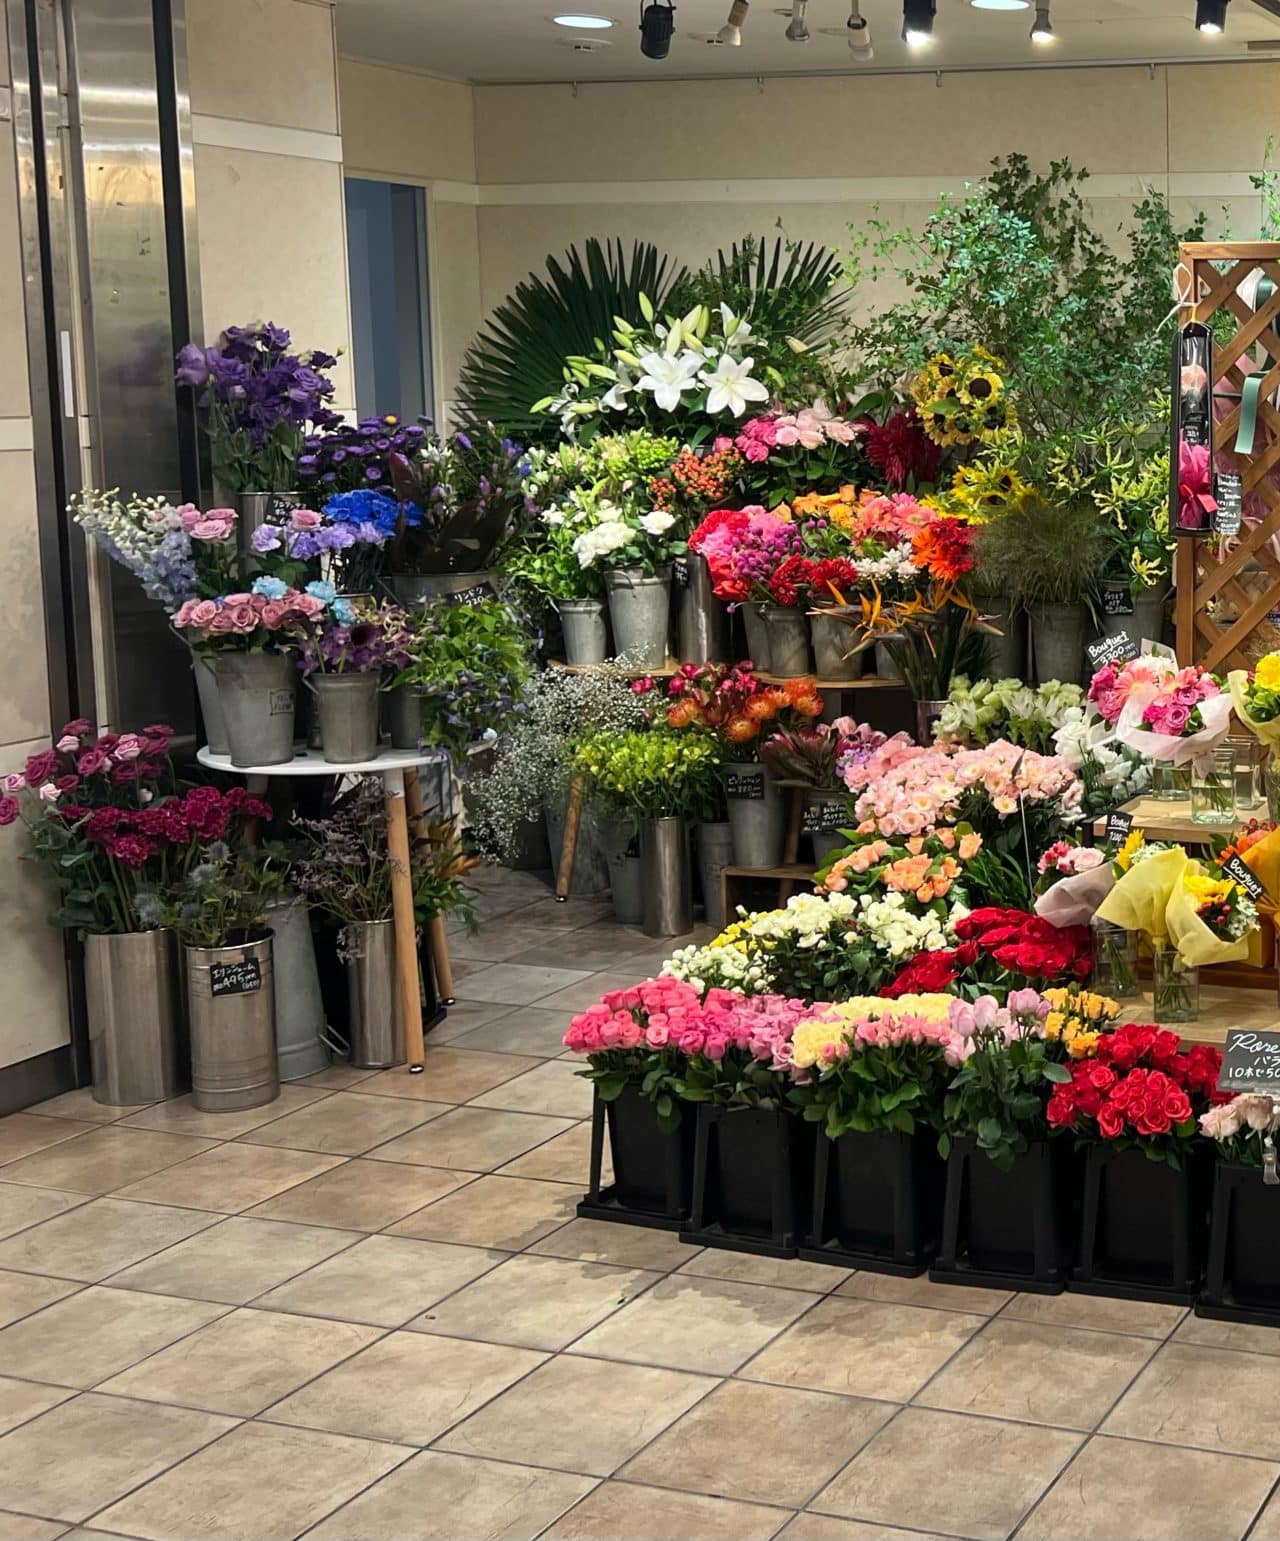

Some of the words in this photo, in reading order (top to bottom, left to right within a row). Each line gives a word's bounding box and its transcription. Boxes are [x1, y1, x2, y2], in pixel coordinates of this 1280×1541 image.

[1088, 631, 1129, 658] Bouquet
[1230, 858, 1263, 897] Bouquet
[223, 972, 245, 988] 495
